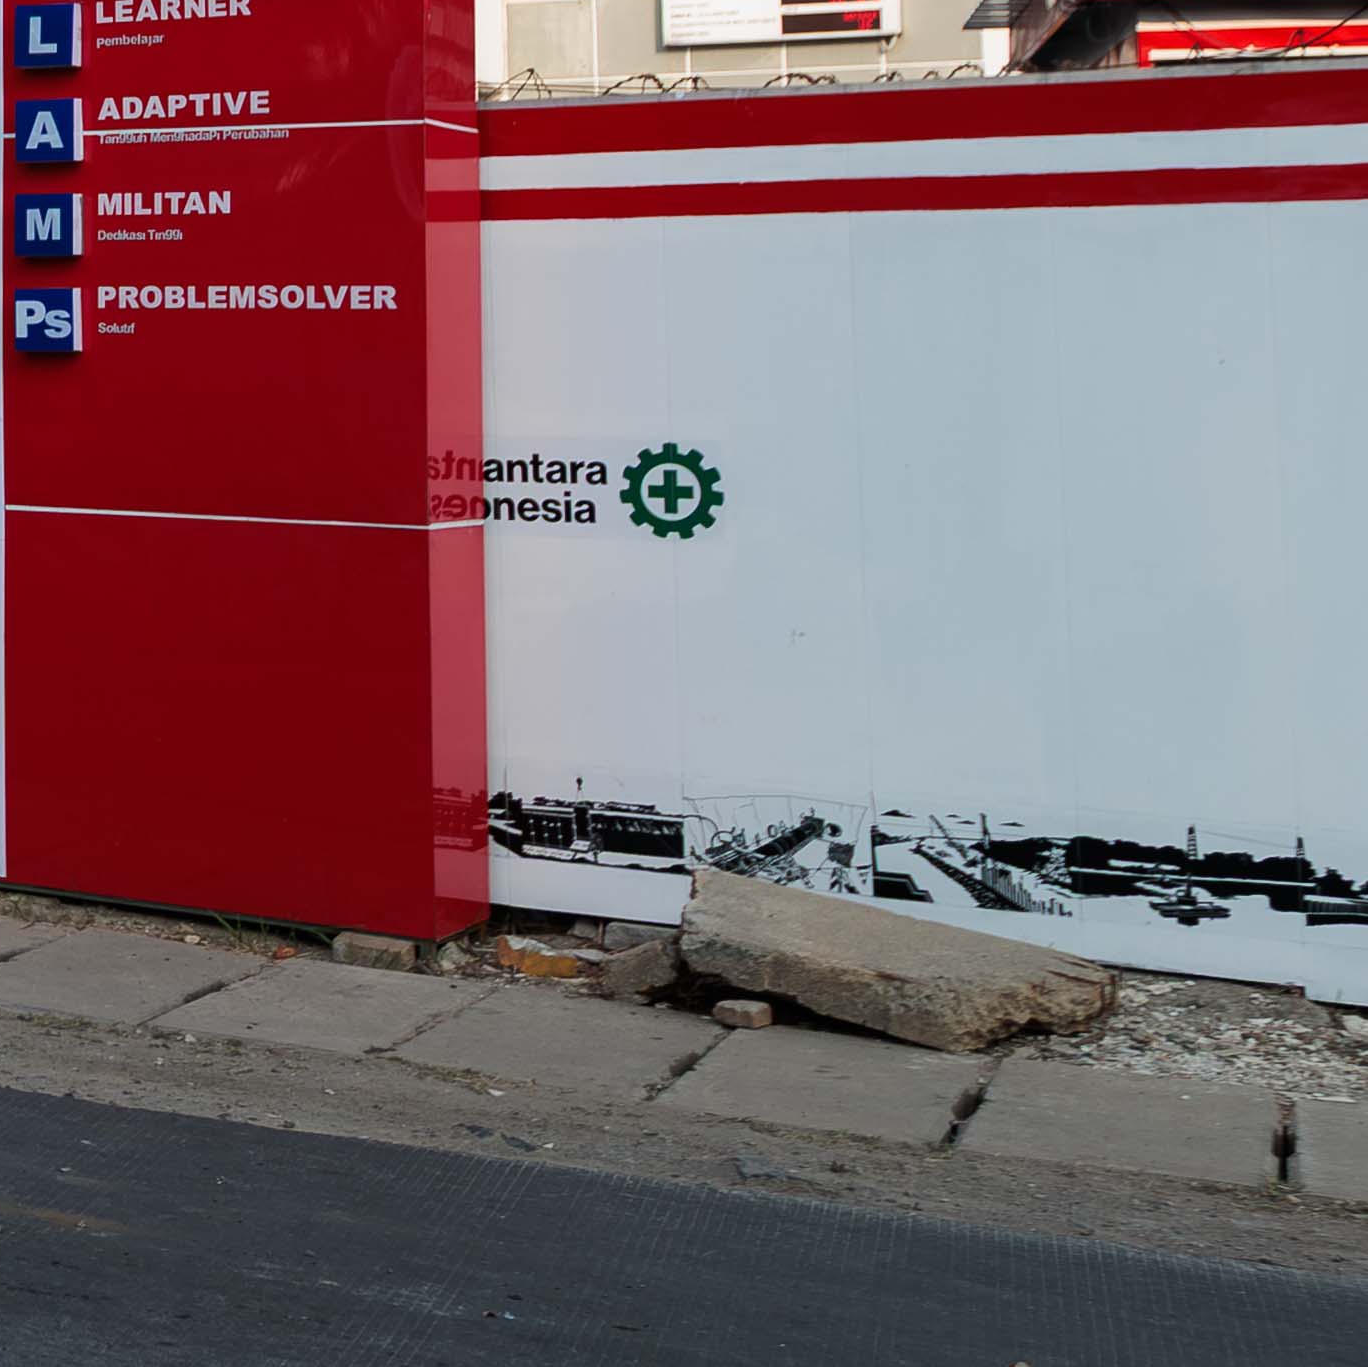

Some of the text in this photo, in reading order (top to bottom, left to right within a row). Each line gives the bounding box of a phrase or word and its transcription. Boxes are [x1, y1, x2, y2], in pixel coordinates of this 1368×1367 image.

[28, 16, 58, 54] L
[98, 90, 271, 121] ADAPTIVE
[25, 111, 64, 150] A
[222, 127, 290, 141] Perubahan
[98, 190, 232, 217] MILITAN
[26, 208, 61, 242] M
[98, 228, 146, 242] Dedikasi
[98, 285, 398, 311] PROBLEMSOLVER
[15, 300, 72, 339] Ps
[98, 321, 135, 335] Solutif
